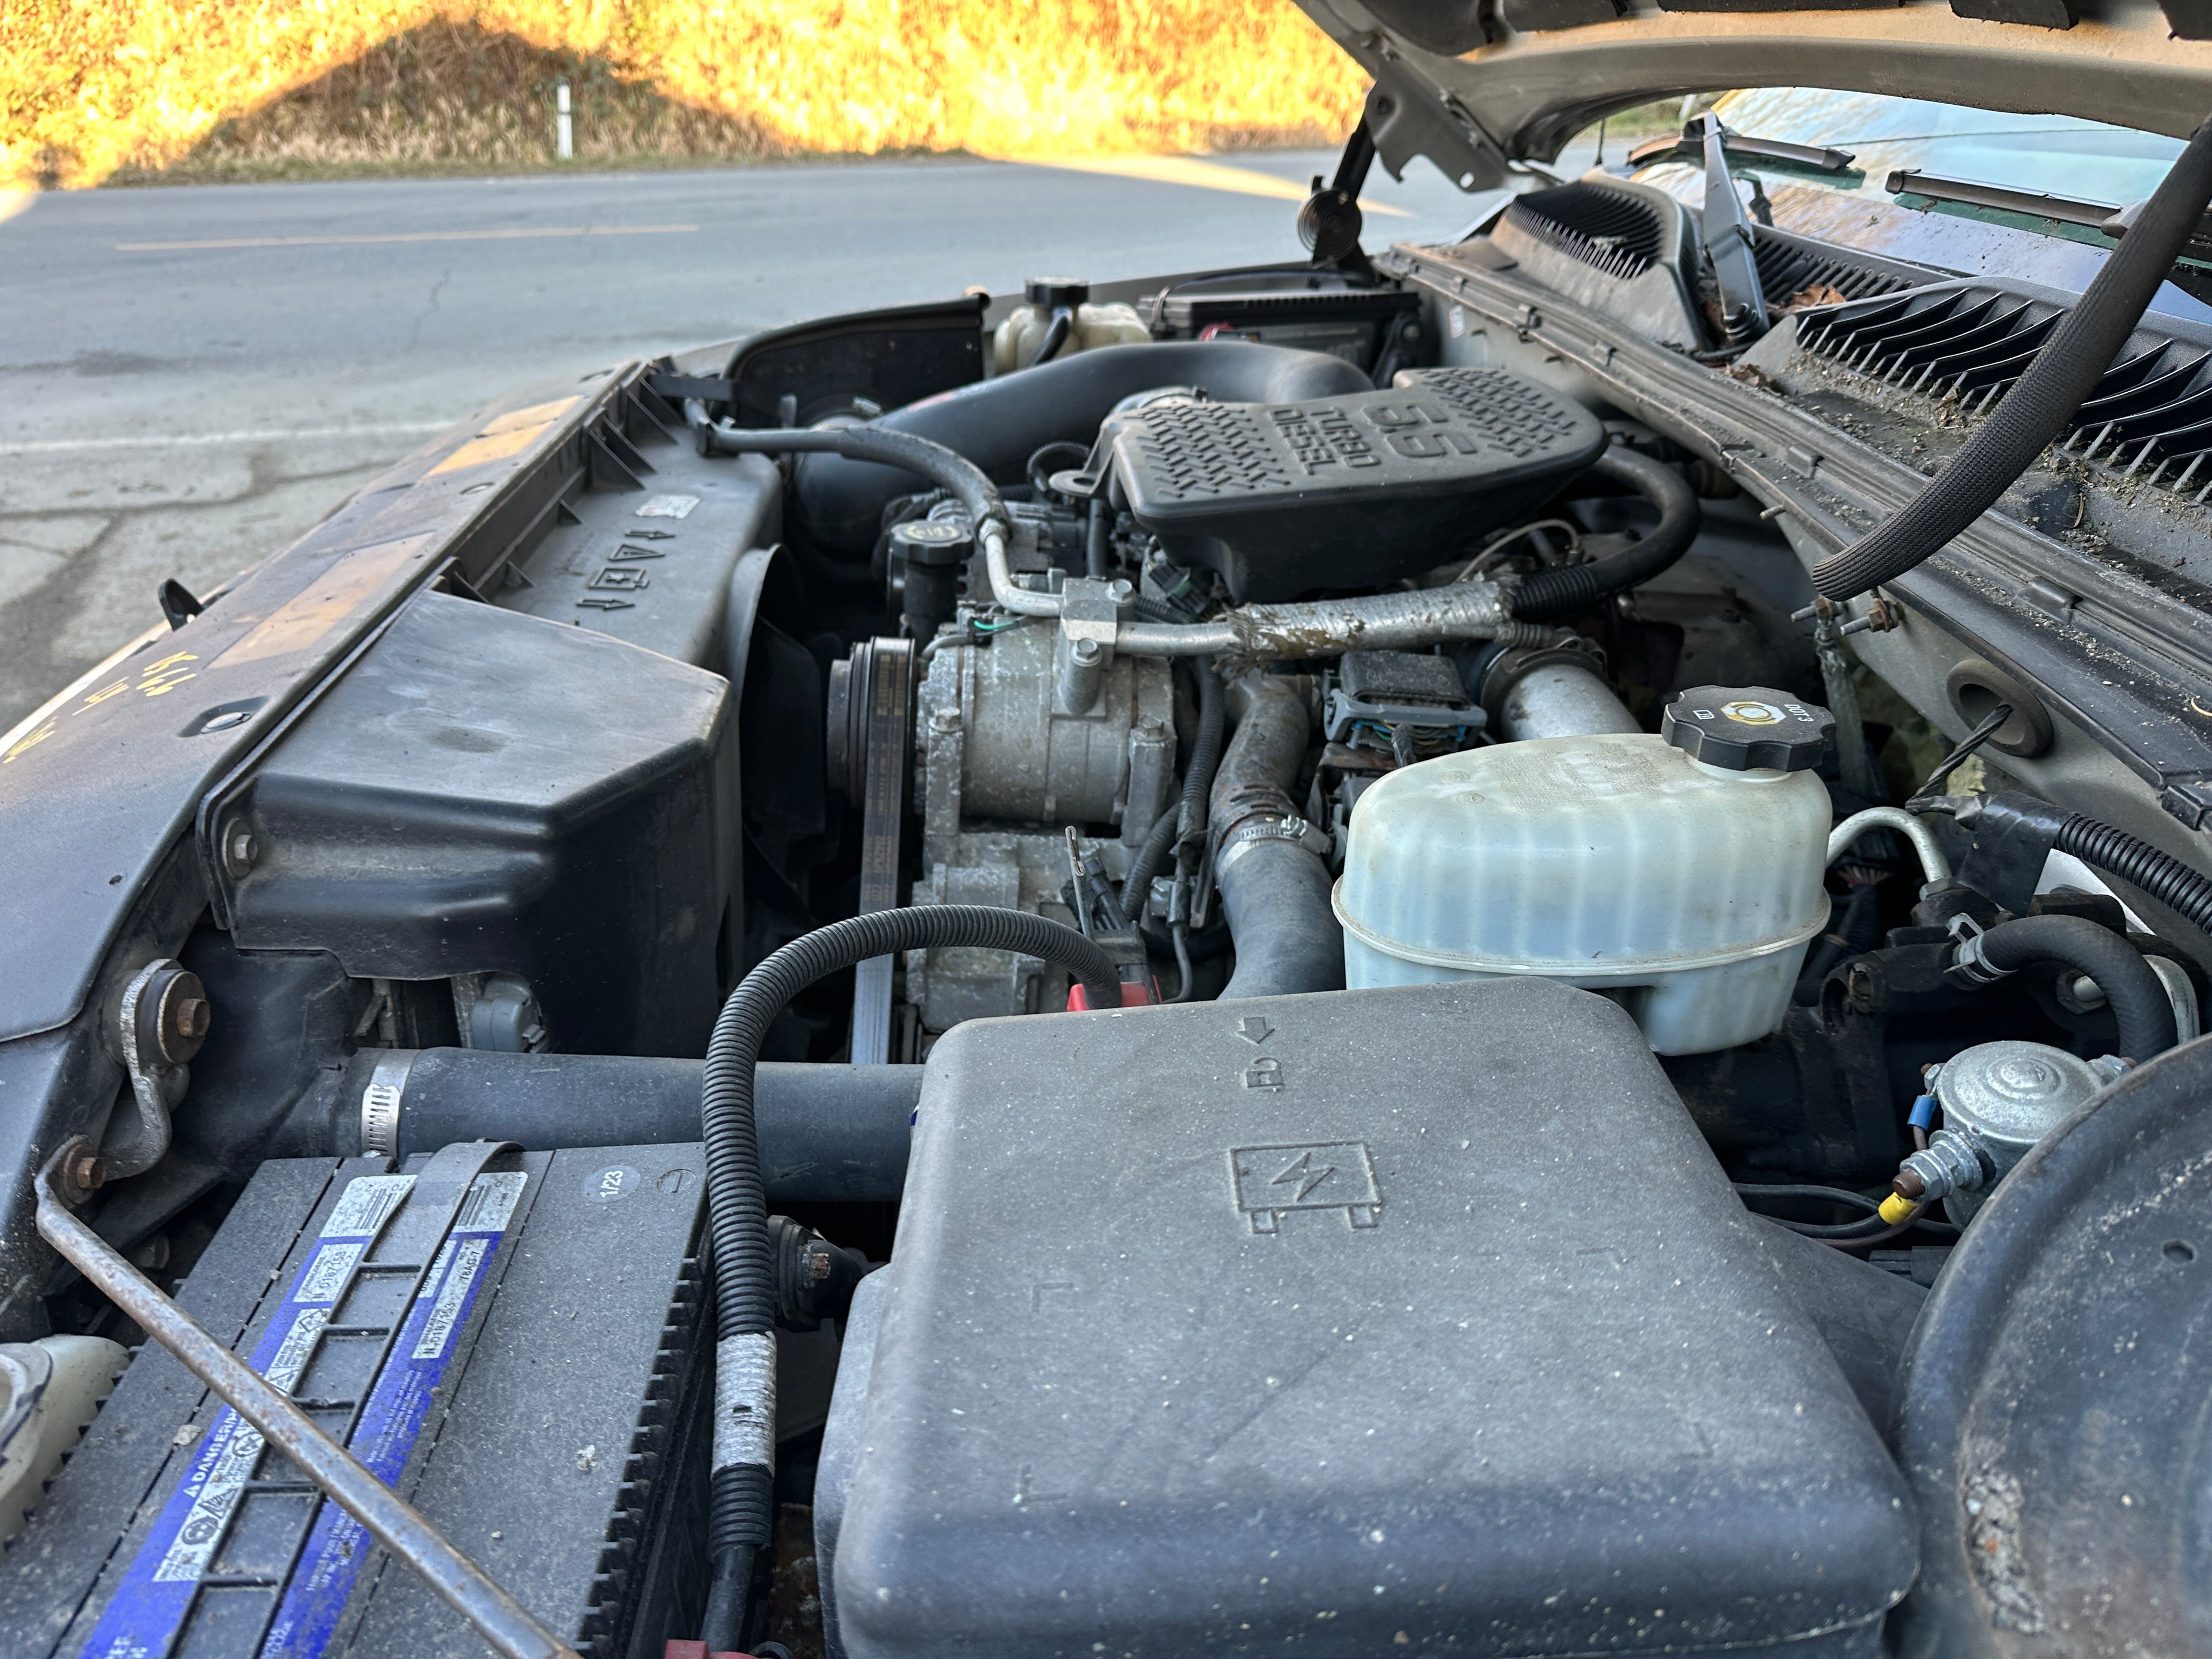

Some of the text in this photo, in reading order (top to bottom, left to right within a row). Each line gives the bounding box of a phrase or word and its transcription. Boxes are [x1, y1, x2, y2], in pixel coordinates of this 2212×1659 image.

[1267, 408, 1337, 476] DIESEL
[1310, 406, 1381, 469] TURBO
[1361, 404, 1478, 459] 6.6
[1783, 704, 1810, 717] DOT
[599, 1170, 624, 1198] 1/23
